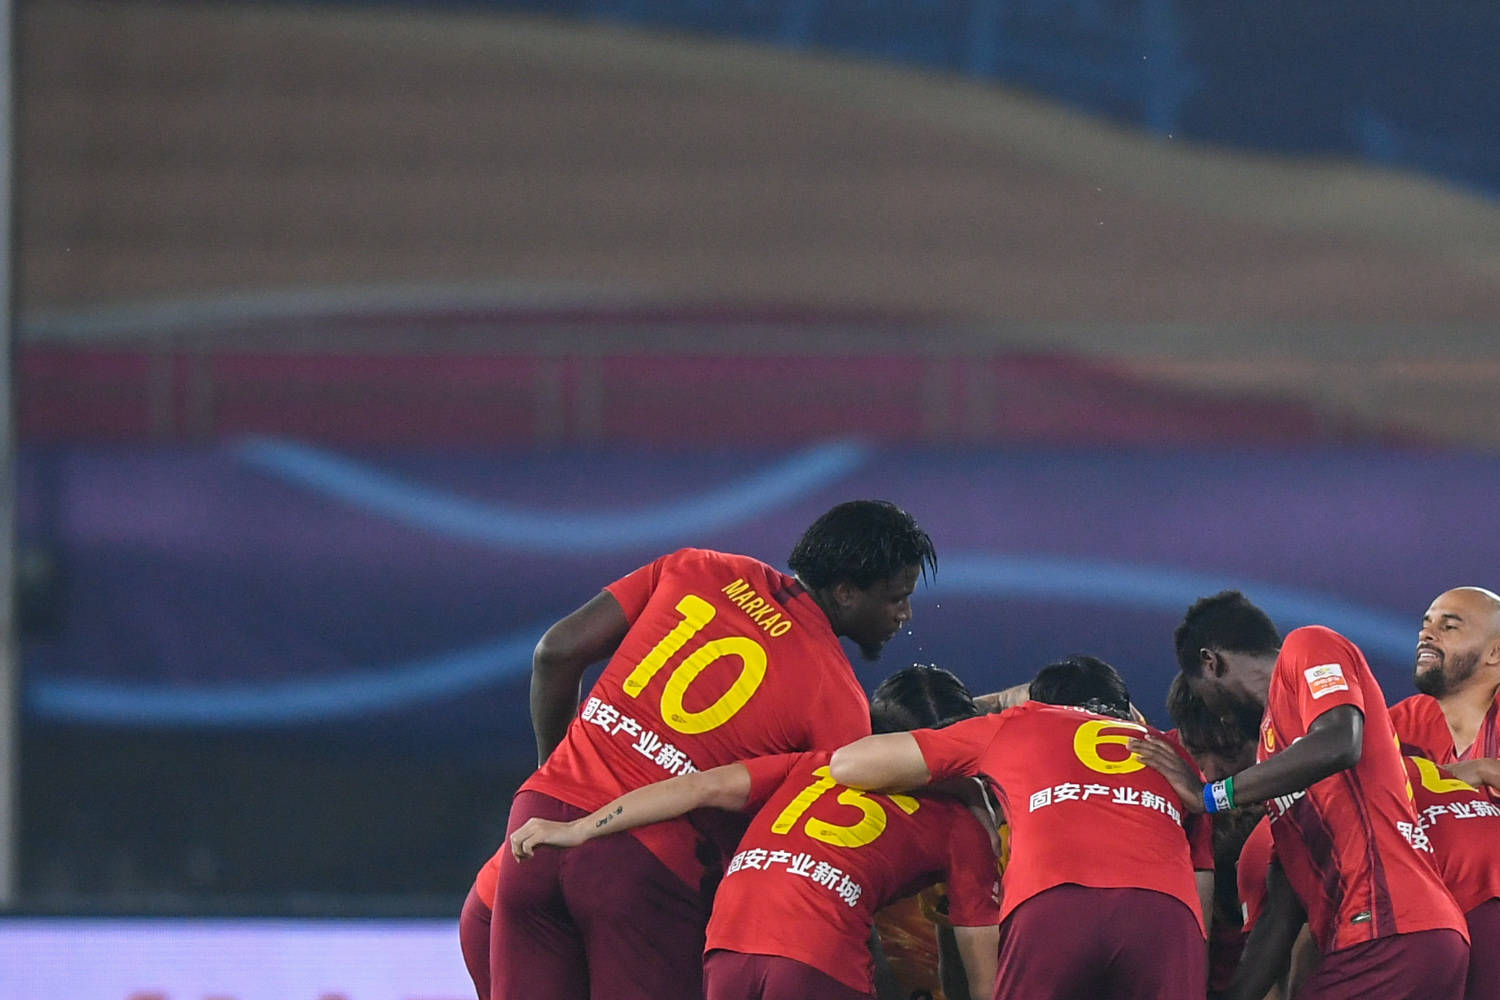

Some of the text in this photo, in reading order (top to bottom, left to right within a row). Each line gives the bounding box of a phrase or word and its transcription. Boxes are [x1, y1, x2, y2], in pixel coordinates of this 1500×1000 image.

[721, 578, 792, 638] MARKAO
[622, 594, 768, 735] 10
[1073, 719, 1148, 774] 6
[771, 765, 920, 848] 15
[727, 848, 862, 908] 固安产业新城
